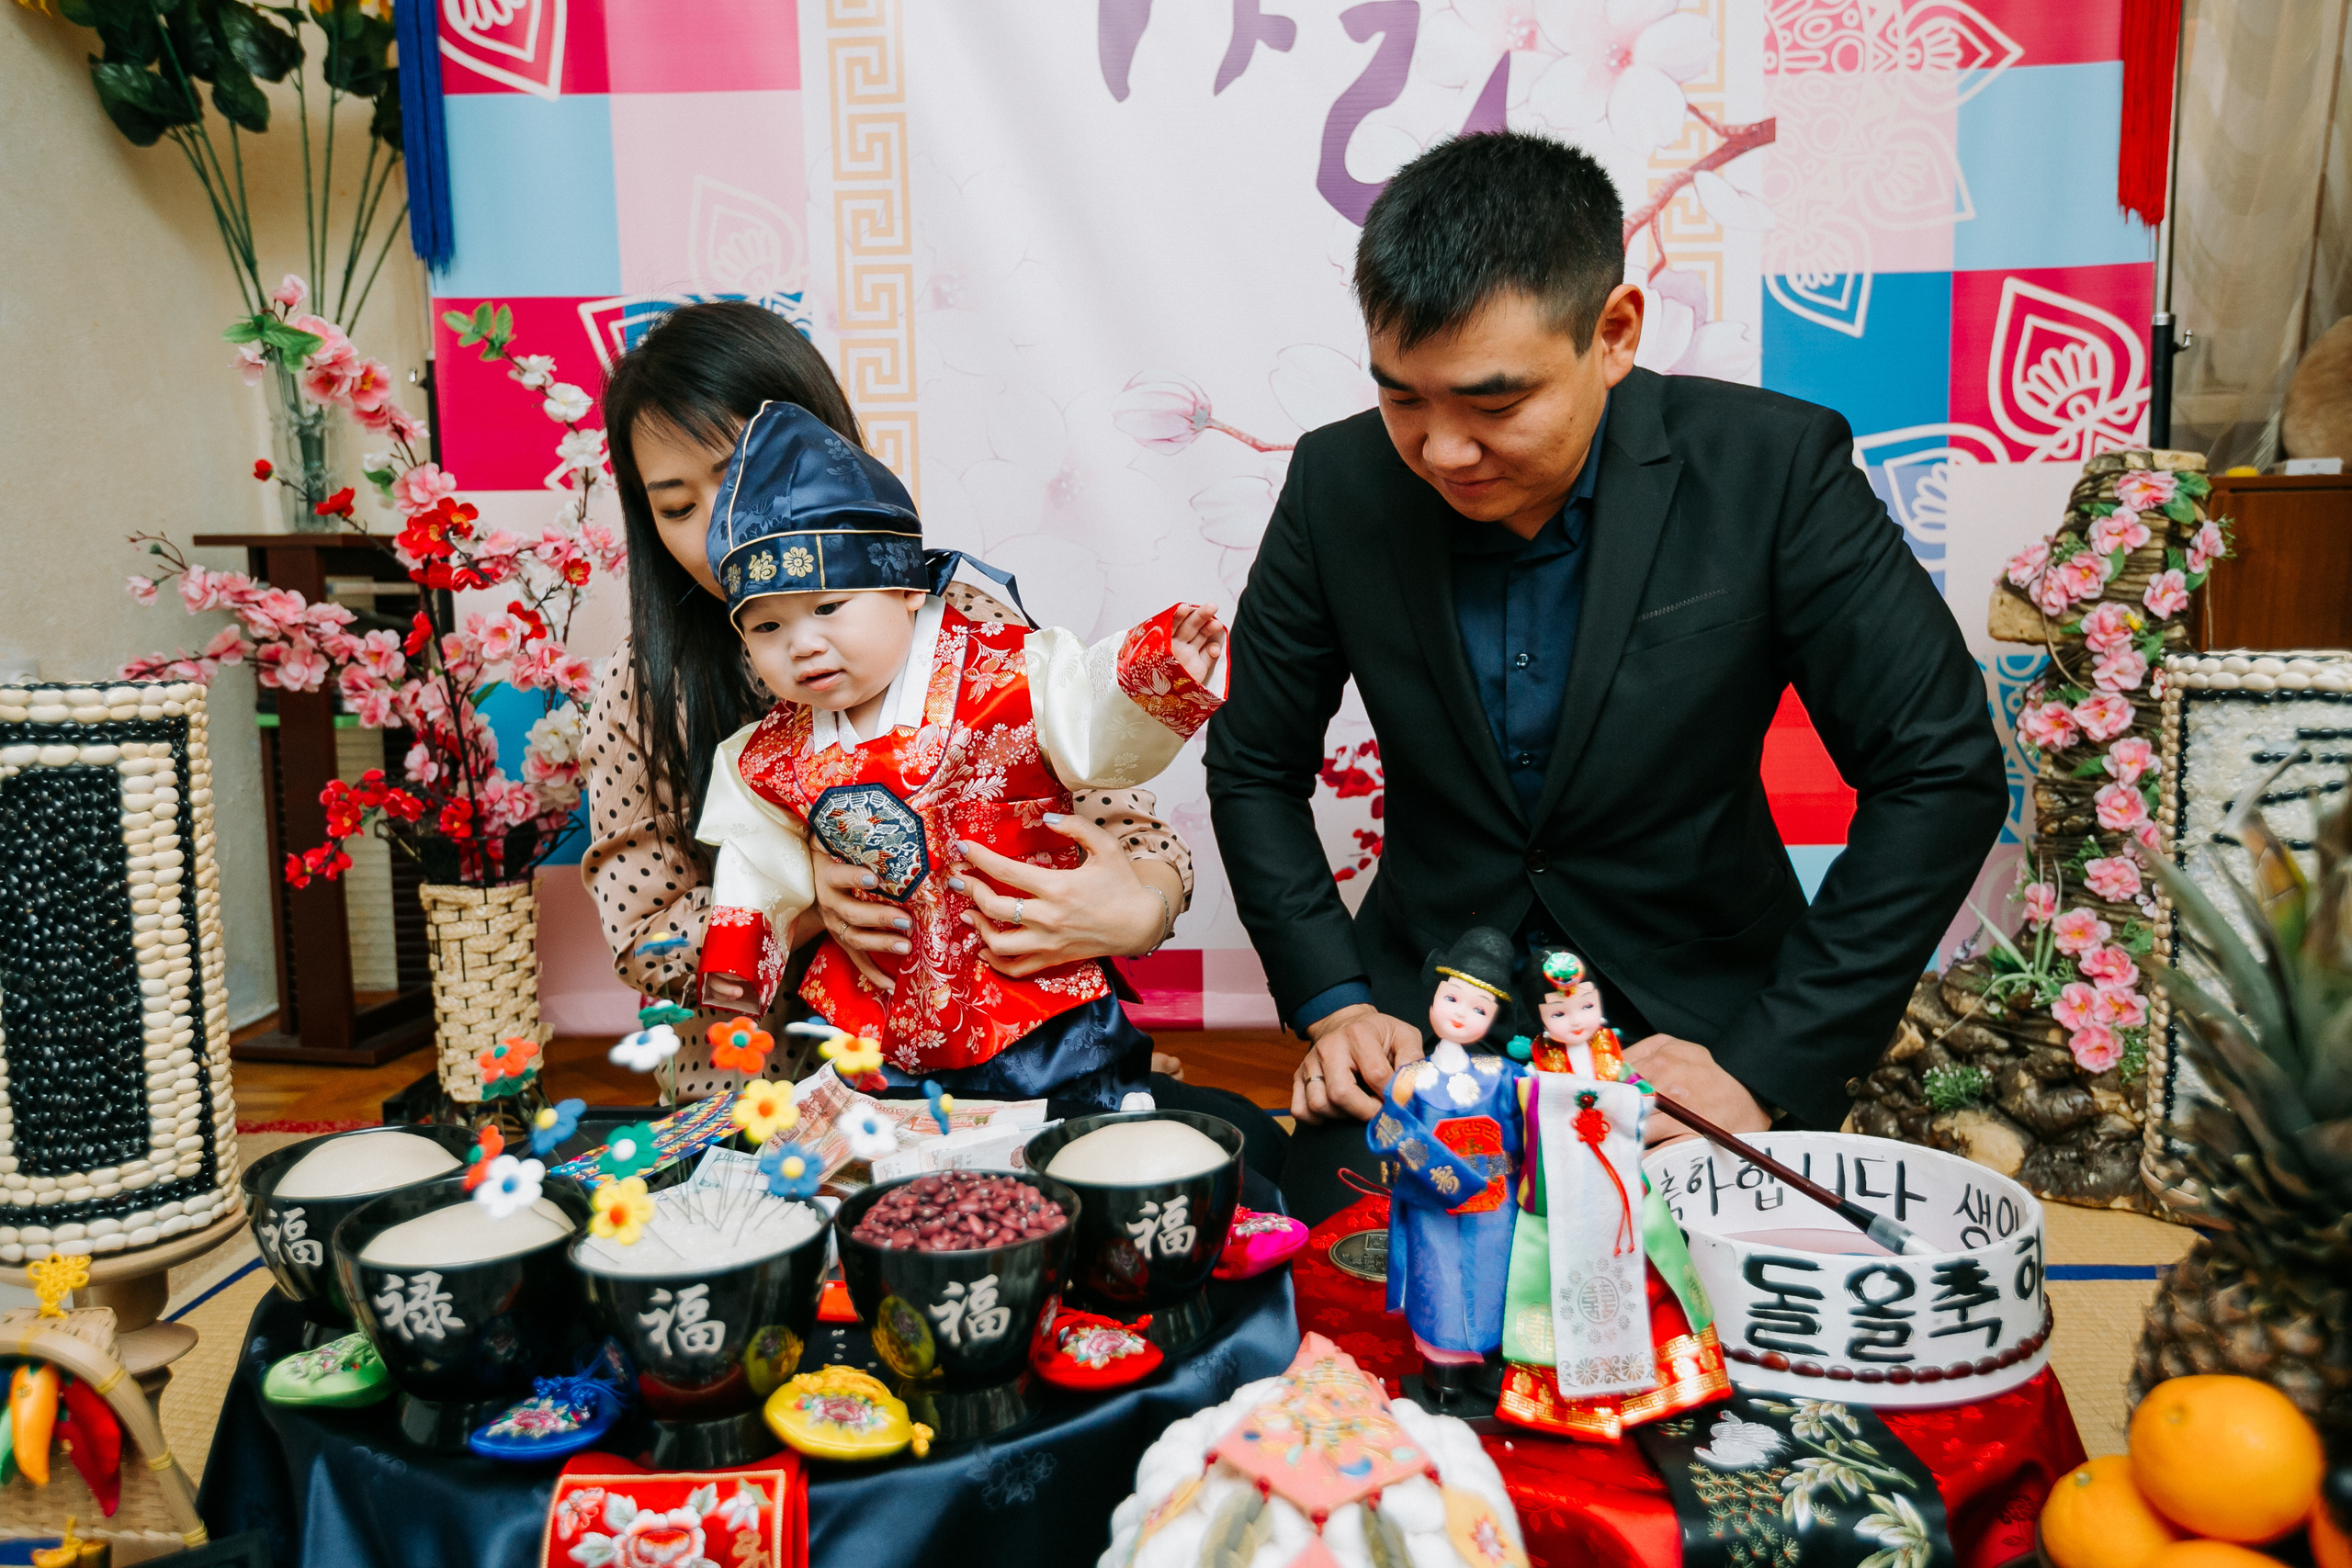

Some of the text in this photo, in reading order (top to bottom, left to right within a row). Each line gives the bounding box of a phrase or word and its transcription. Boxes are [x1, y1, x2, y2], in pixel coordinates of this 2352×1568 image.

[261, 1207, 323, 1267] 福
[1125, 1195, 1196, 1260] 福
[639, 1283, 727, 1358] 福
[929, 1273, 1011, 1347] 福
